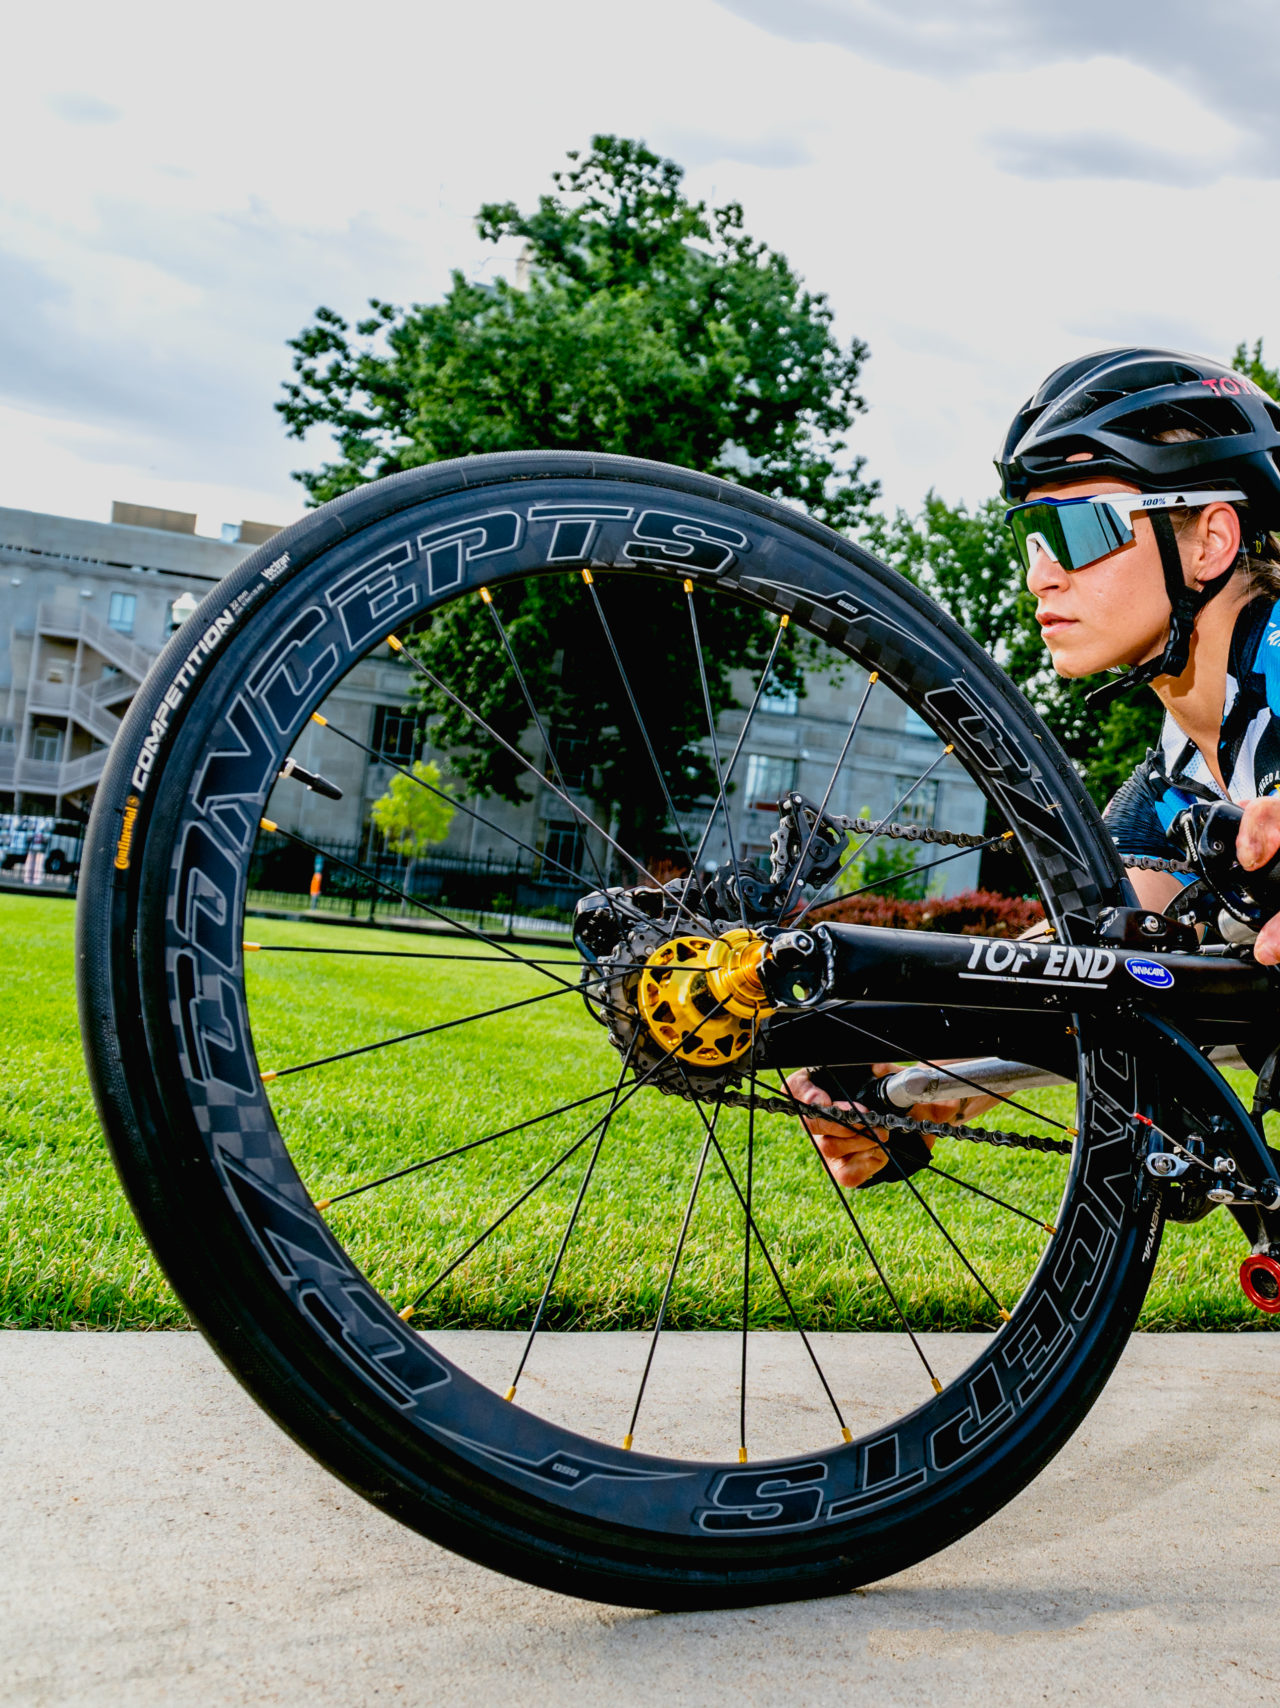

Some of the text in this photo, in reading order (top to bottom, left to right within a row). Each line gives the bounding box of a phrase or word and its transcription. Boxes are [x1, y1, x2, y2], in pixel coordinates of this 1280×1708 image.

[1141, 497, 1166, 506] 100%
[114, 806, 138, 870] Continental
[132, 608, 235, 792] COMPETITION
[173, 502, 748, 1097] CONCEPTS
[967, 937, 1117, 979] TOP END
